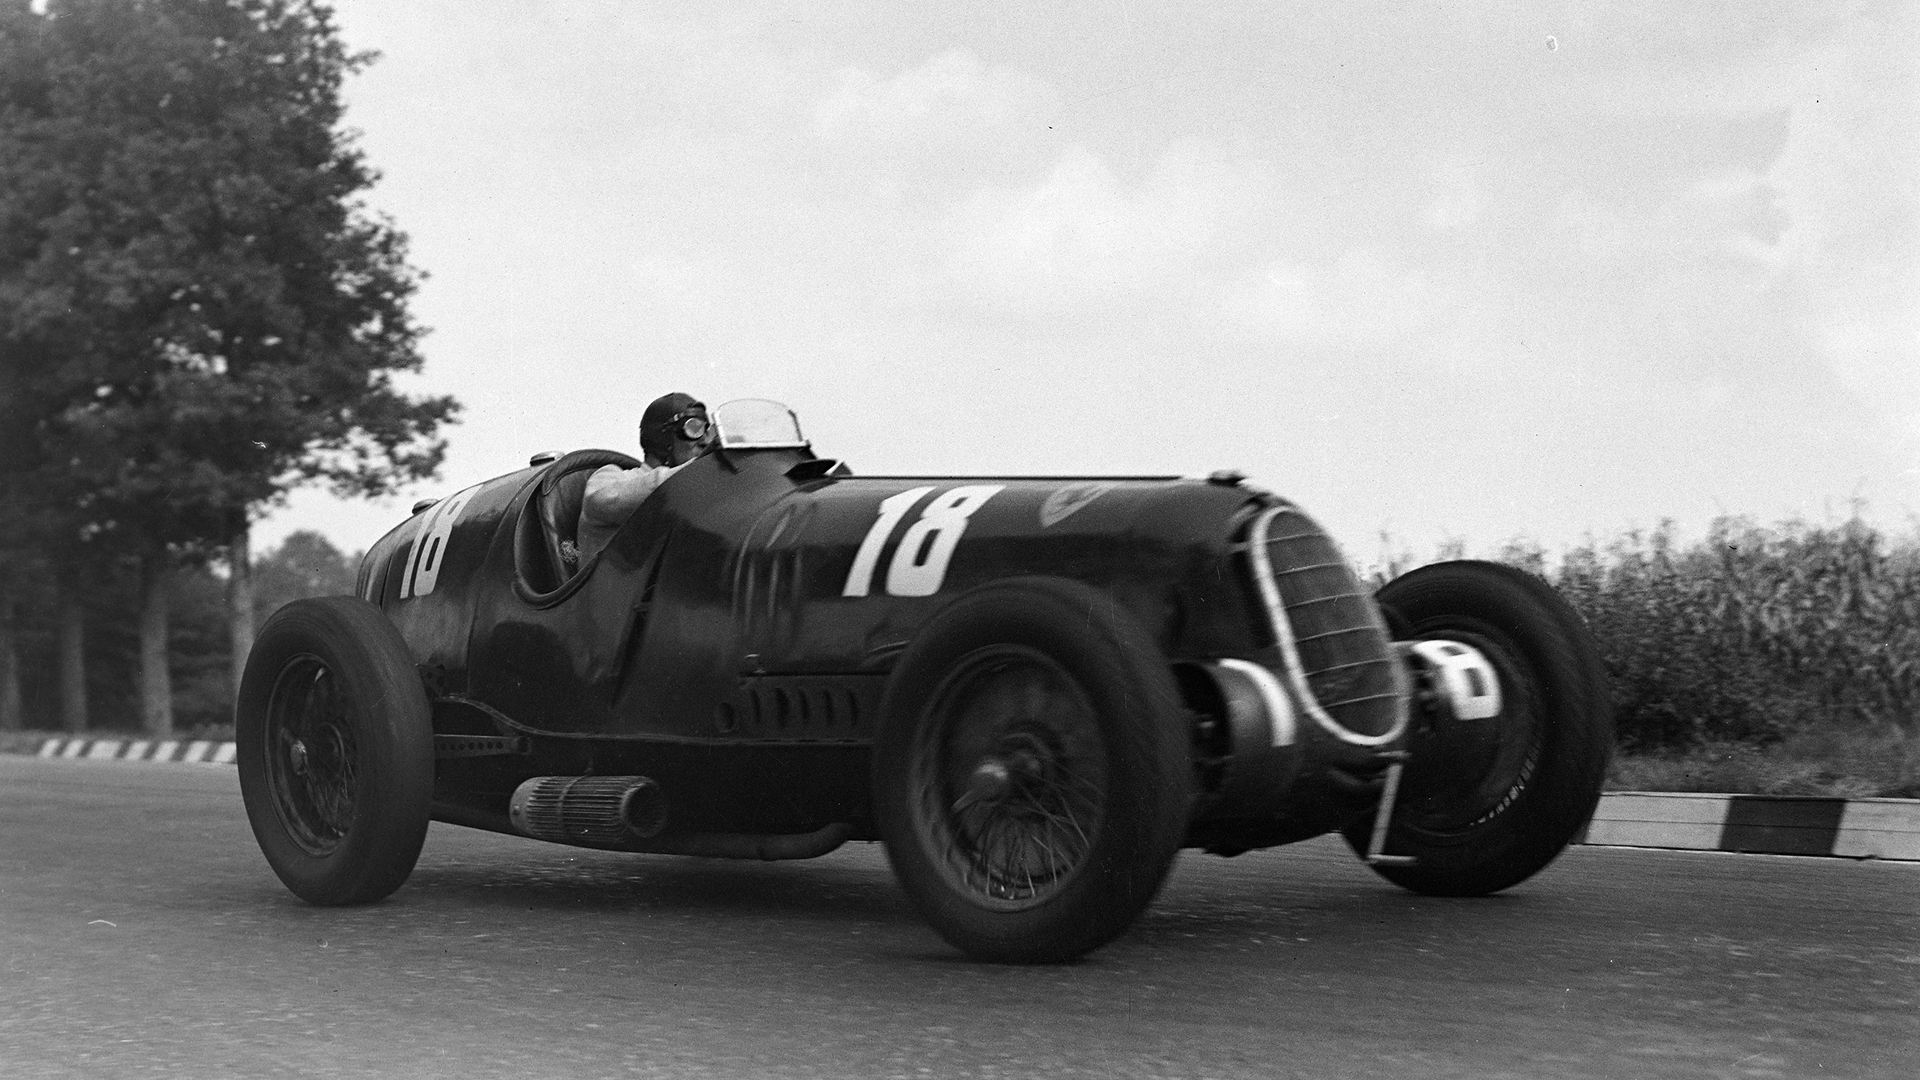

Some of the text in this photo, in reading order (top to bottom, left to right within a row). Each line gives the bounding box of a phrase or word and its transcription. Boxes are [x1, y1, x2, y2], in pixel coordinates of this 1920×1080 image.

[400, 483, 484, 599] 18
[842, 484, 1006, 597] 18
[1411, 640, 1503, 720] 8
